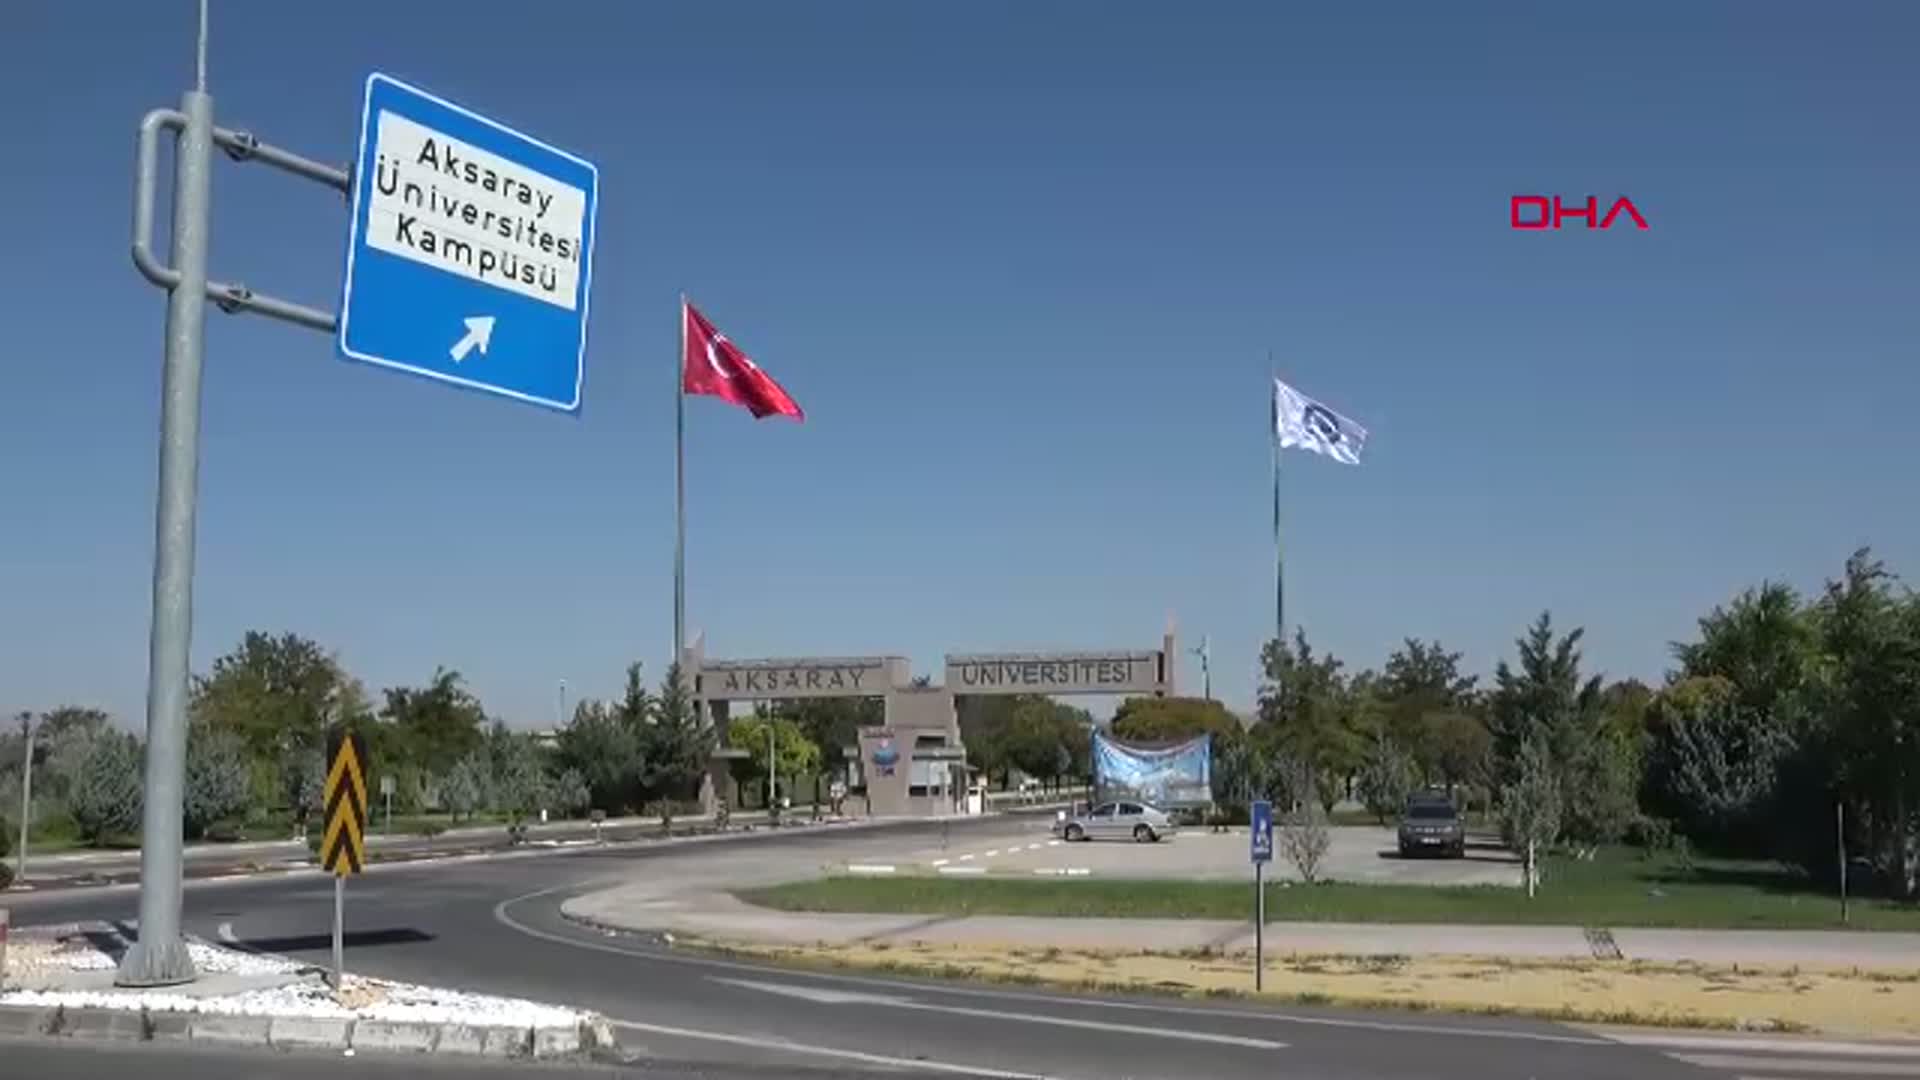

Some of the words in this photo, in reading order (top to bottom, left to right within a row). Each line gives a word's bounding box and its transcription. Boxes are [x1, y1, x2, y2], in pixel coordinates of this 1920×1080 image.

[375, 154, 580, 263] Üniversitesi
[417, 137, 555, 218] Aksaray
[395, 212, 557, 293] Kampüsü
[724, 669, 866, 690] AKSARAY
